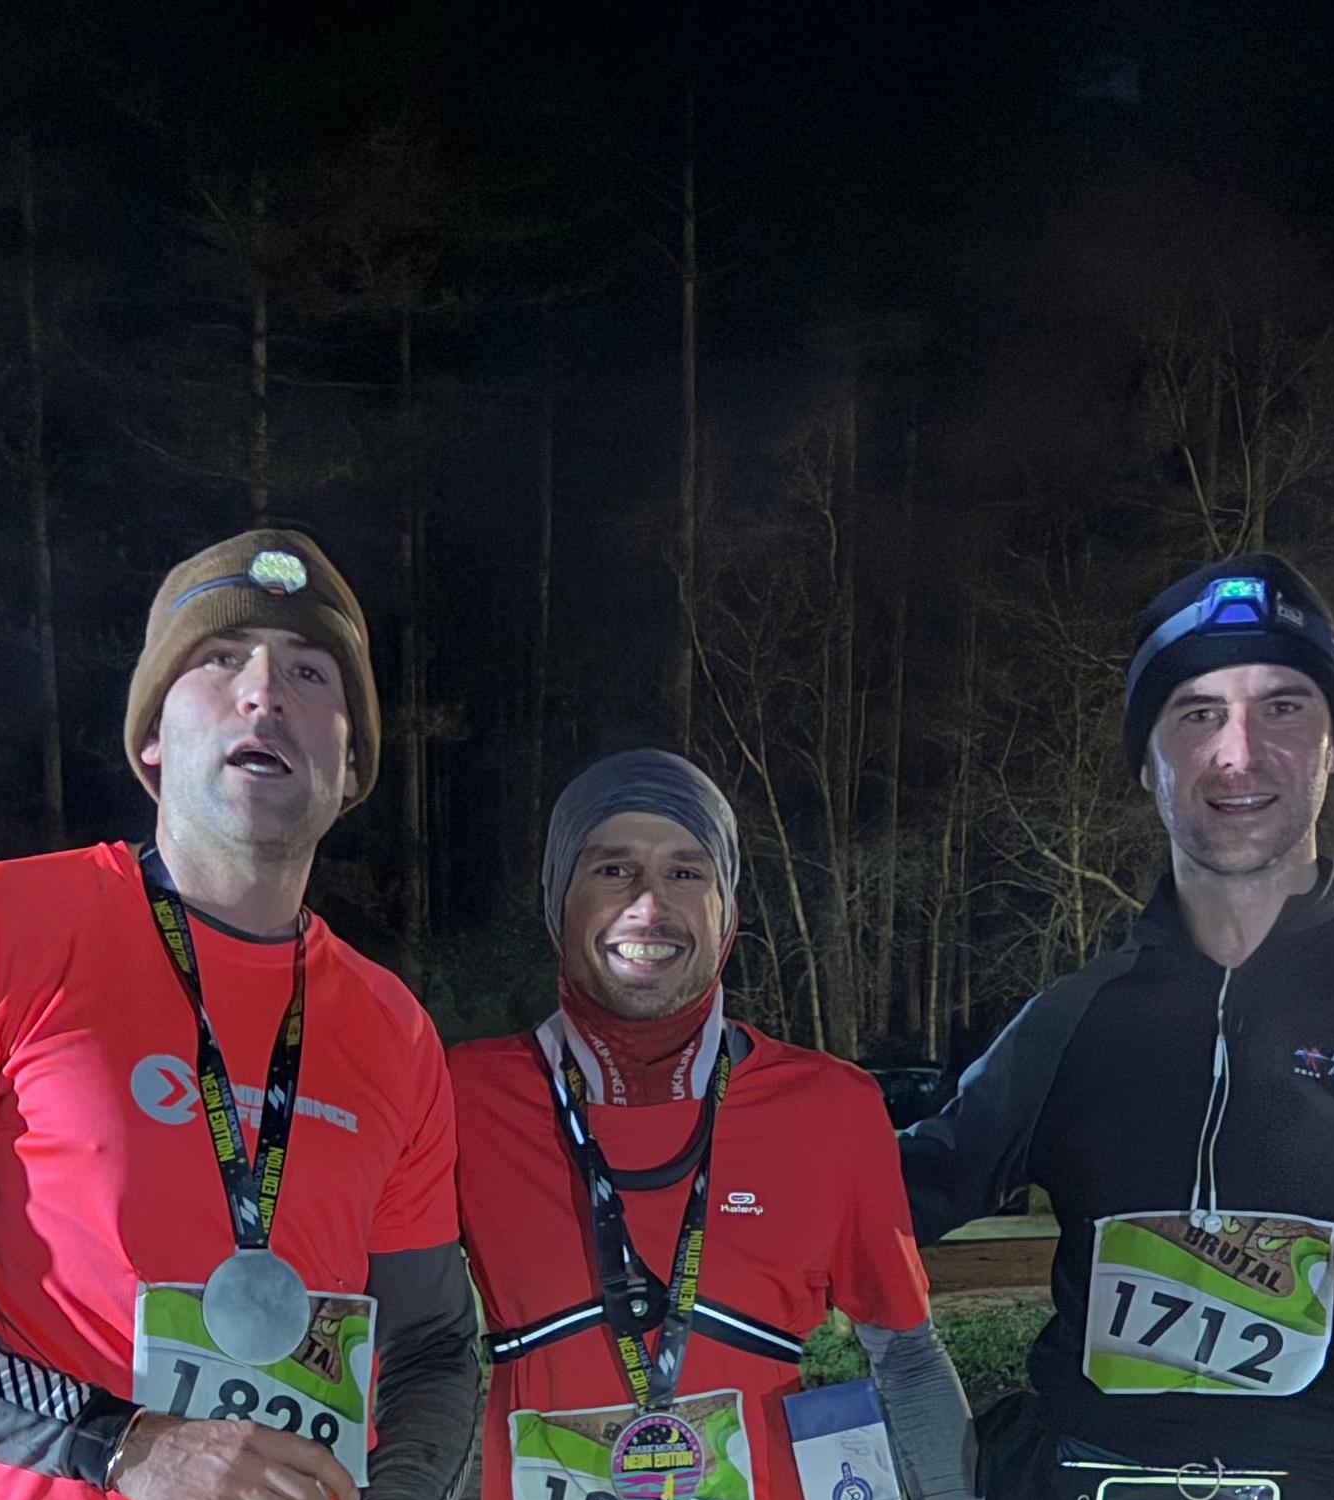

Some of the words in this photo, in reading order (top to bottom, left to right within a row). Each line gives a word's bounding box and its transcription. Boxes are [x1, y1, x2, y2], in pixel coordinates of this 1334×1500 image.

[201, 1073, 224, 1109] NEON
[208, 1110, 236, 1162] EDITION
[262, 1146, 284, 1195] EDITION
[684, 1230, 704, 1276] EDITION
[1183, 1228, 1283, 1293] BRUTAL
[678, 1278, 697, 1312] NEON
[618, 1336, 643, 1370] NEON
[1109, 1280, 1284, 1384] 1712
